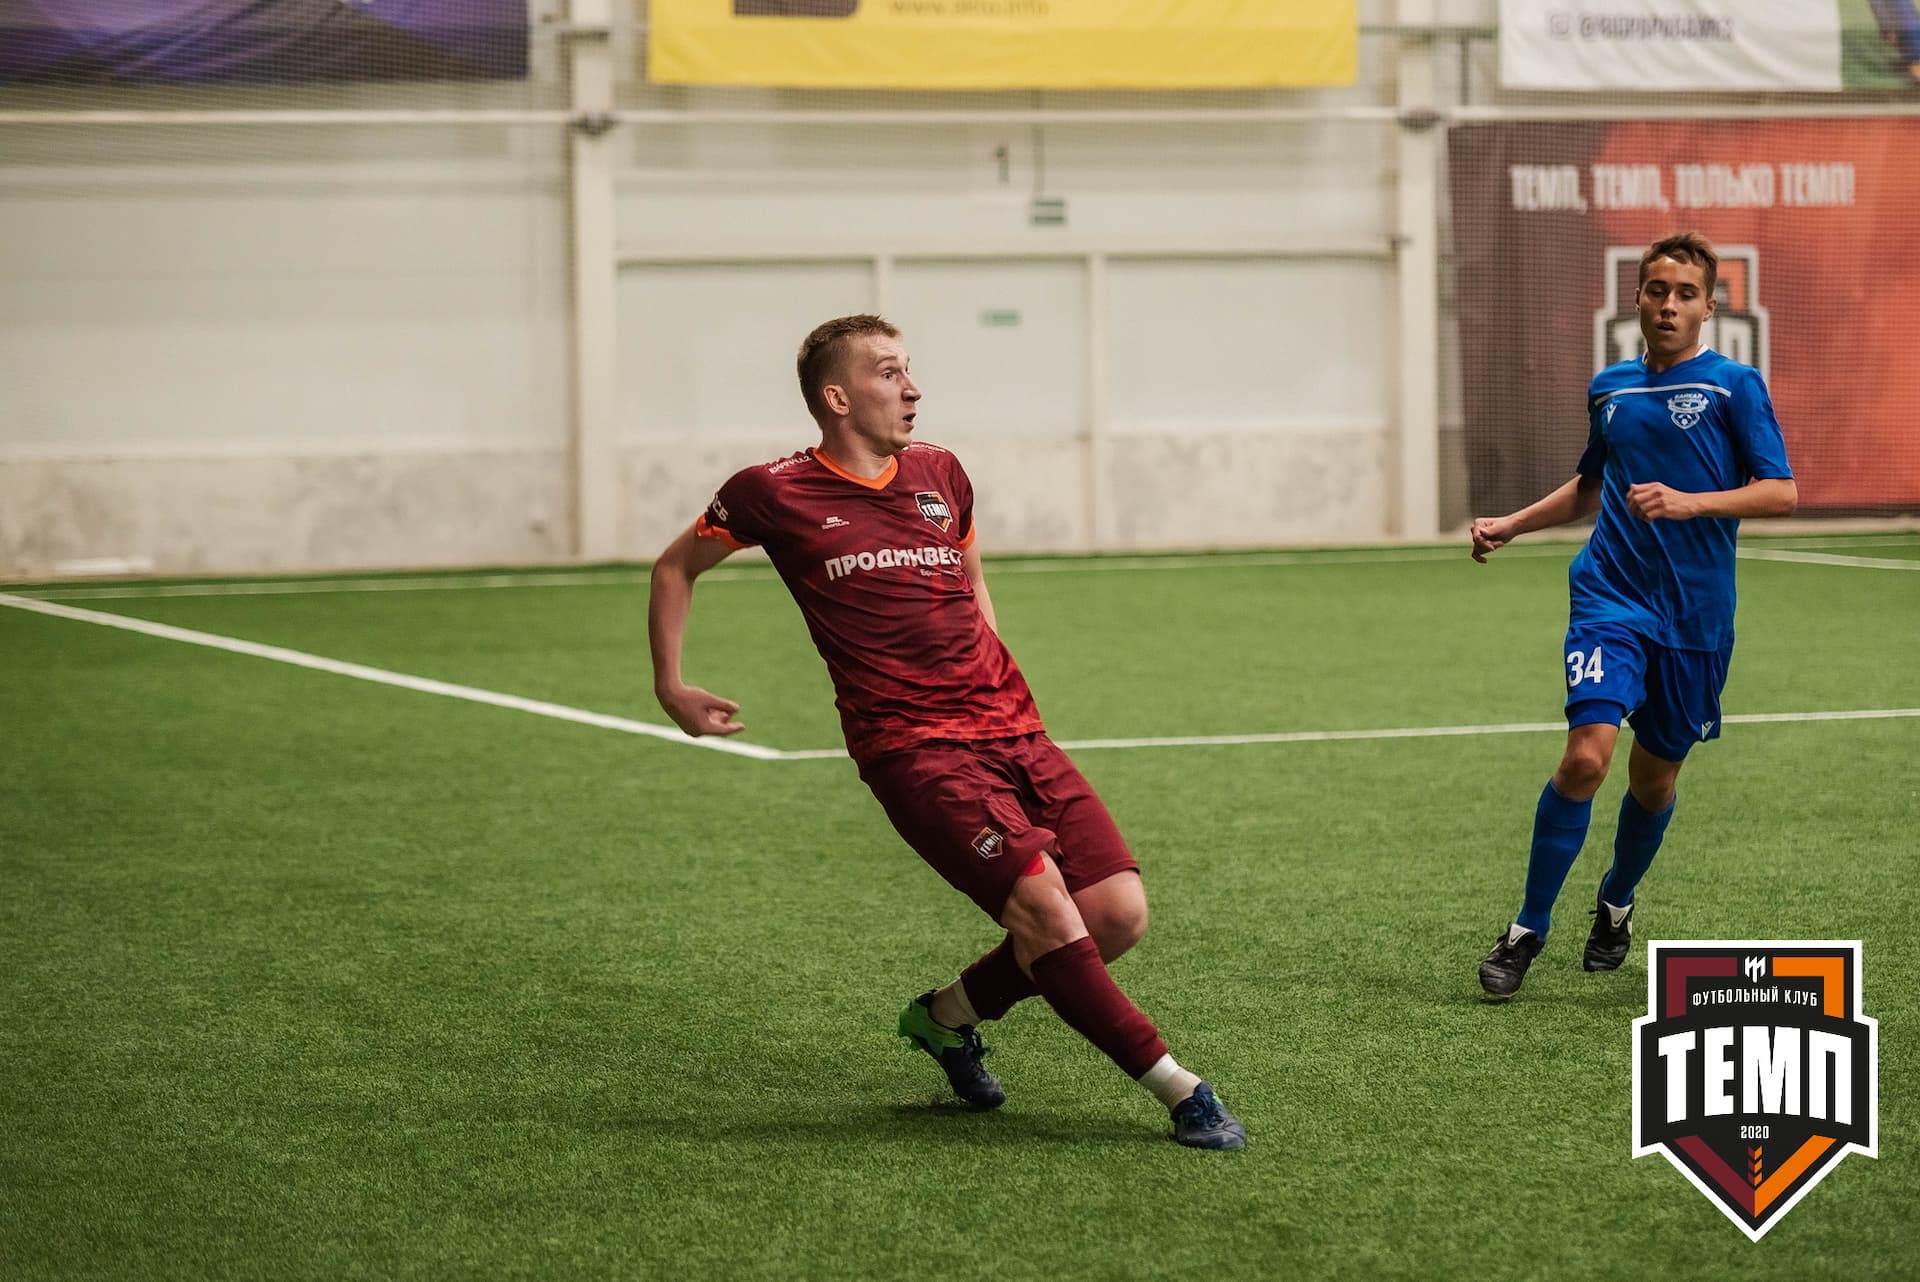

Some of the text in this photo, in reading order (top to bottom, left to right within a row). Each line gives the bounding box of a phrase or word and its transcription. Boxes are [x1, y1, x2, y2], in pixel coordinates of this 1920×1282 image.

[1511, 163, 1855, 214] ТЕМП, ТЕМП, ТОЛЬКО ТЕМП!
[920, 503, 949, 518] ТЕМП
[1566, 646, 1604, 687] 34
